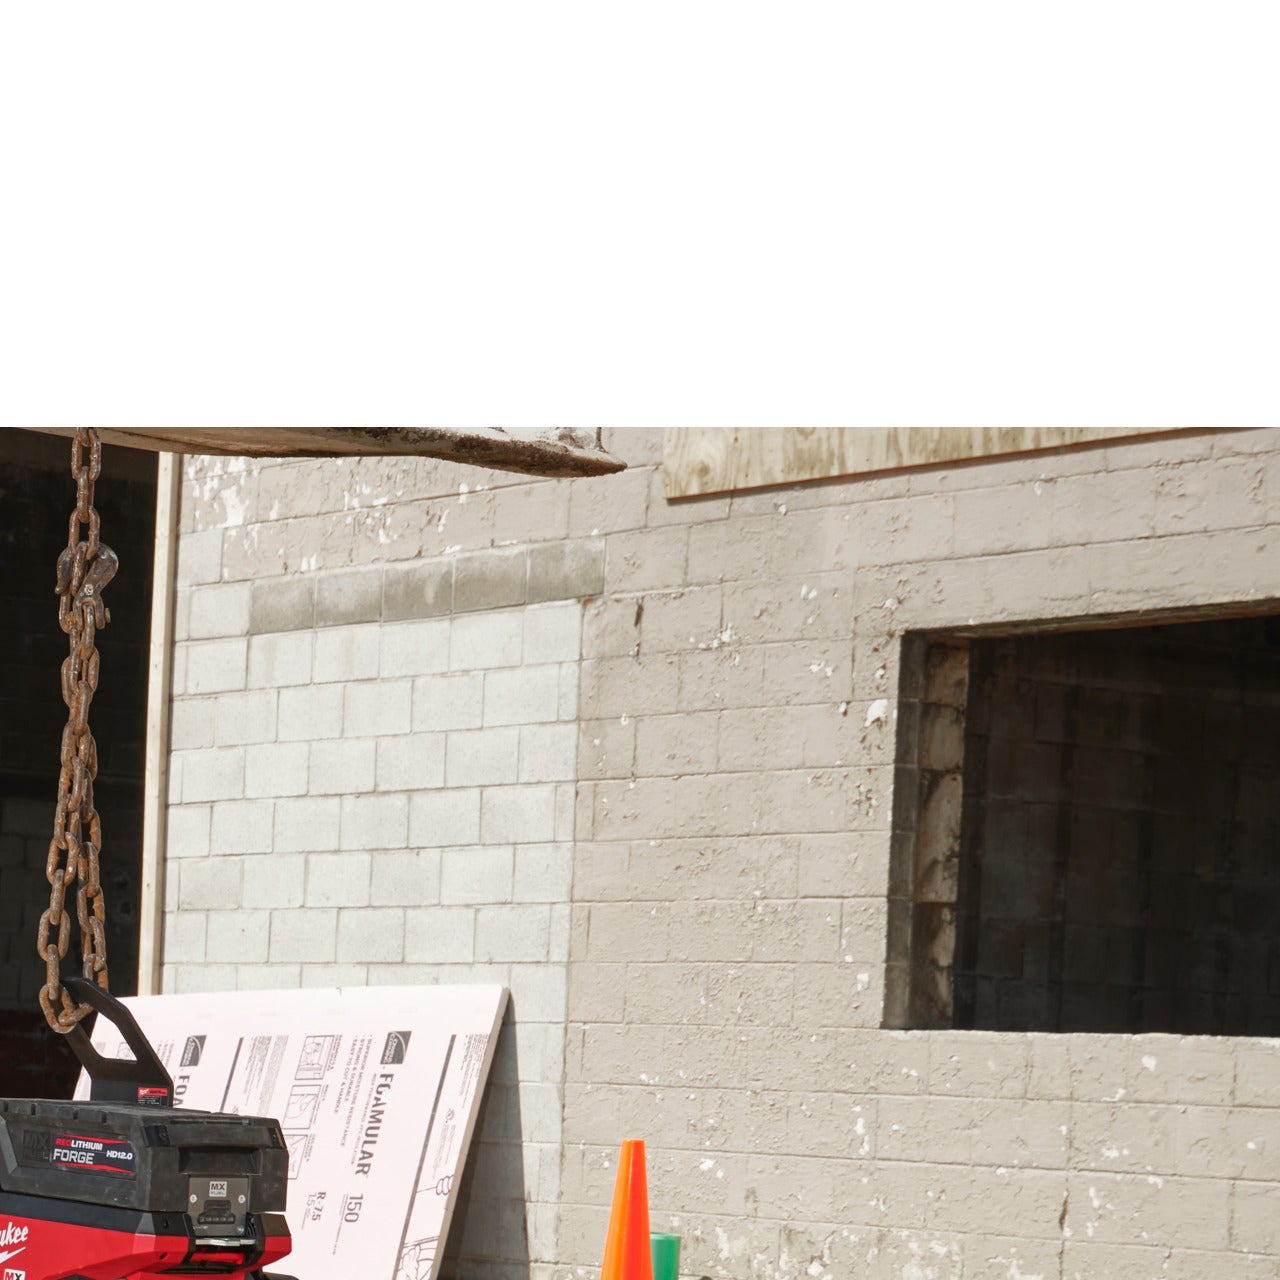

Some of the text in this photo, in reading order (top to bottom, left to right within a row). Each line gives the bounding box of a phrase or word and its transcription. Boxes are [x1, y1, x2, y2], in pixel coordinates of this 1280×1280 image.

[55, 1138, 103, 1151] REDLITHIUM
[53, 1148, 95, 1164] FORGE
[106, 1150, 133, 1160] HD12.0
[344, 1193, 364, 1223] 150
